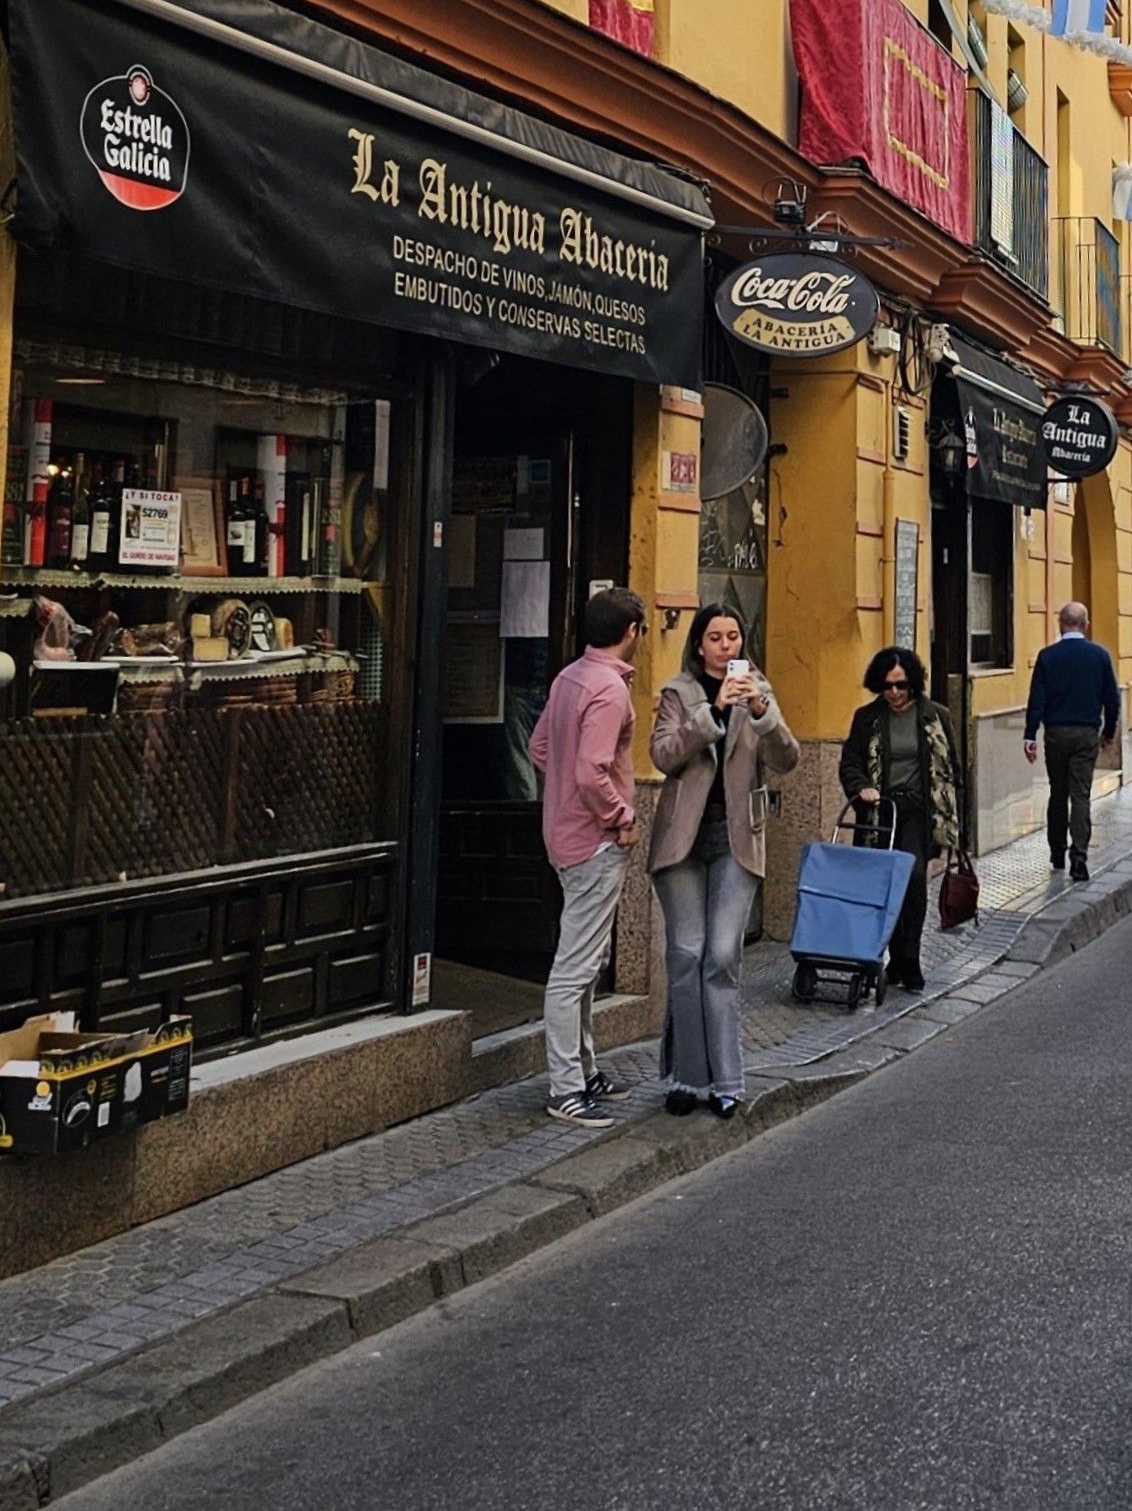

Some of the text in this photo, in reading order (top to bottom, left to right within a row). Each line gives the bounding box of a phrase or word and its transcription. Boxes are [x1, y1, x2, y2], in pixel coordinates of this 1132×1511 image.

[100, 98, 173, 150] Estrella
[104, 133, 171, 182] Galicia
[348, 128, 400, 208] La
[418, 158, 546, 255] Antigua
[393, 235, 478, 280] DESPACHO
[481, 260, 500, 286] DE
[394, 272, 647, 355] EMBUTIDOS Y CONSERVAS SELECTAS
[730, 267, 857, 315] Coca-Cola
[742, 324, 846, 349] LA ANTIGUA
[752, 317, 838, 337] ABACERÍA
[1042, 421, 1107, 449] Antigua
[1067, 404, 1091, 425] La
[139, 492, 149, 500] SI
[151, 493, 178, 501] TOCA?
